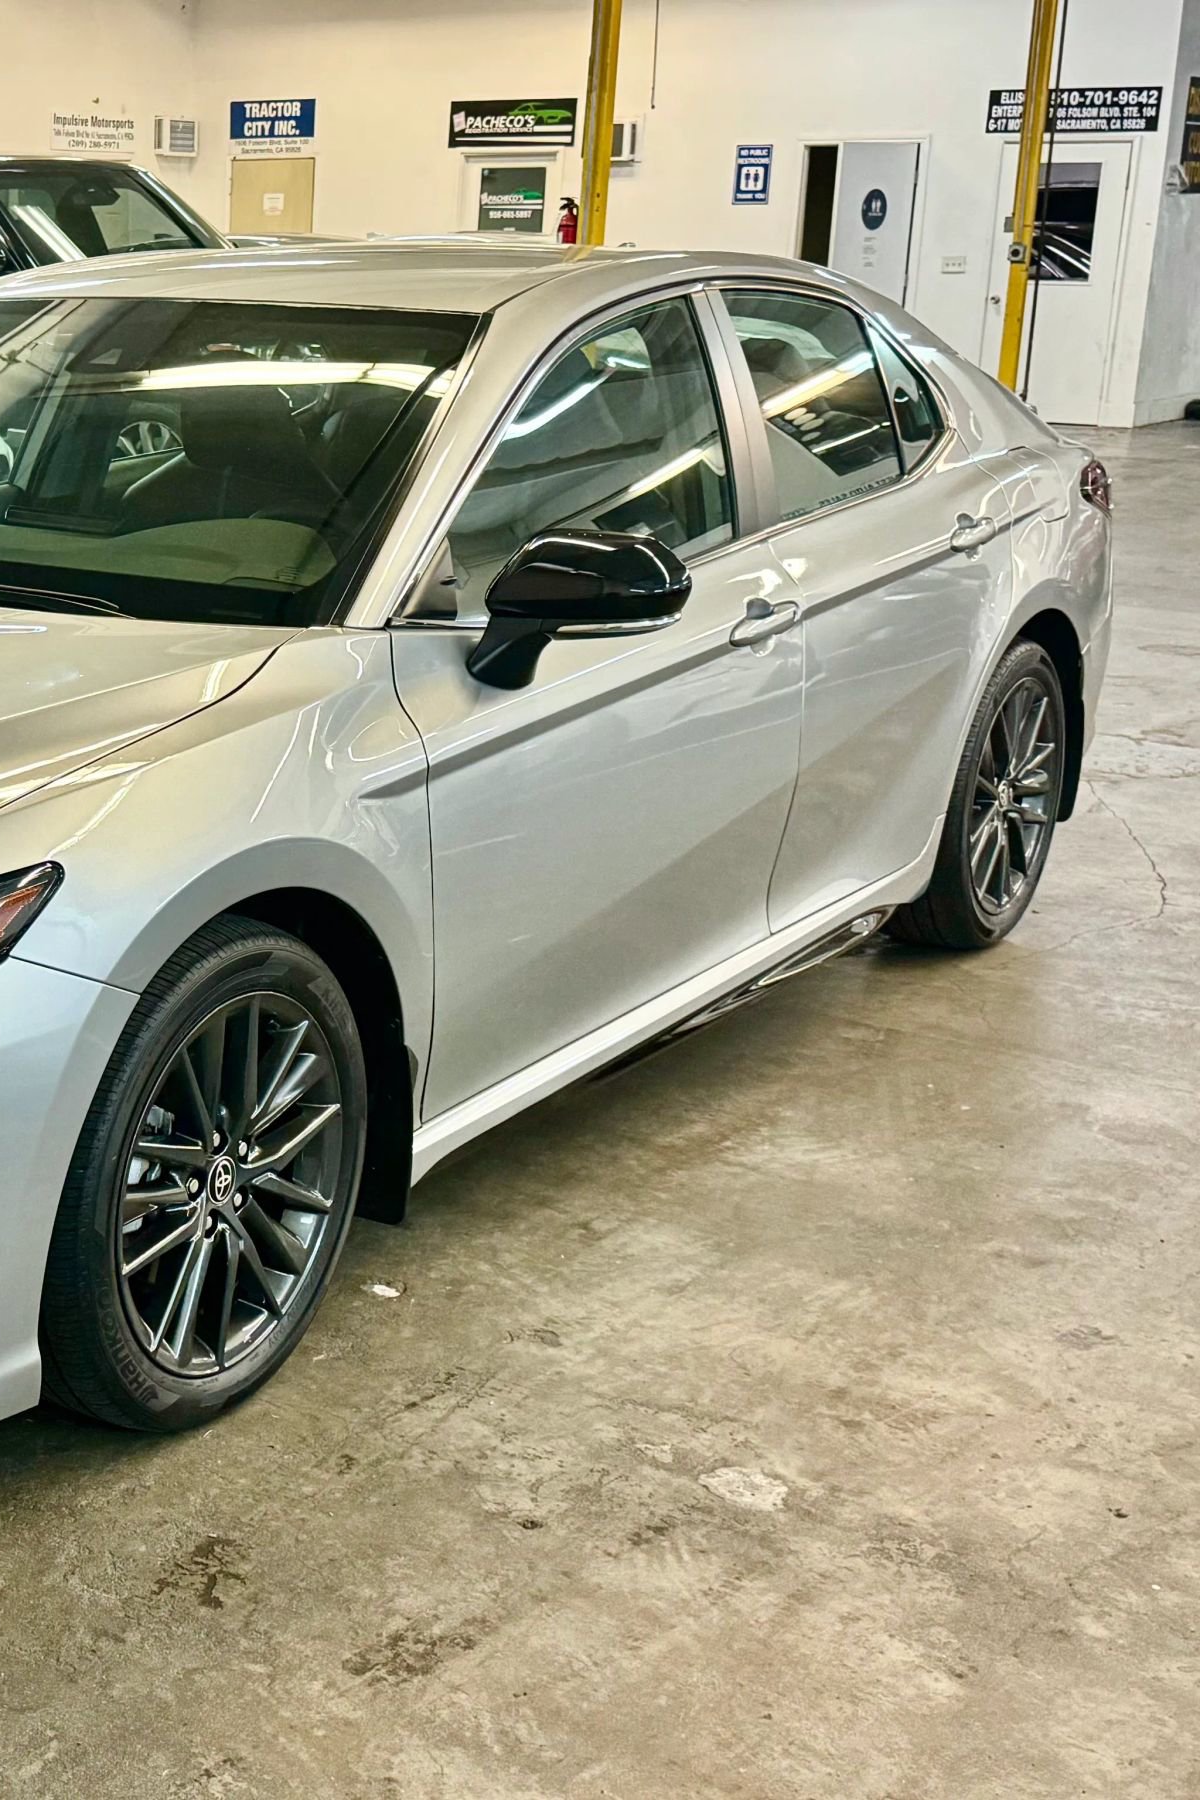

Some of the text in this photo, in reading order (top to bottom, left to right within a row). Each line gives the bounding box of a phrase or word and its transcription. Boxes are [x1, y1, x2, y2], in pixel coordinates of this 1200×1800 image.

[1001, 91, 1025, 104] ELLIS
[244, 101, 301, 118] TRACTOR
[991, 105, 1023, 118] ENTERP
[1067, 107, 1099, 118] FOLSOM
[1123, 106, 1140, 117] STE.
[1143, 106, 1156, 117] 104
[53, 113, 135, 131] Impulsive Motorsports
[466, 114, 536, 128] PACHECO'S
[988, 119, 1006, 131] G-17
[1110, 119, 1121, 130] CA
[1123, 118, 1146, 130] 95826
[243, 120, 300, 136] CITY INC.
[68, 139, 87, 148] (209)
